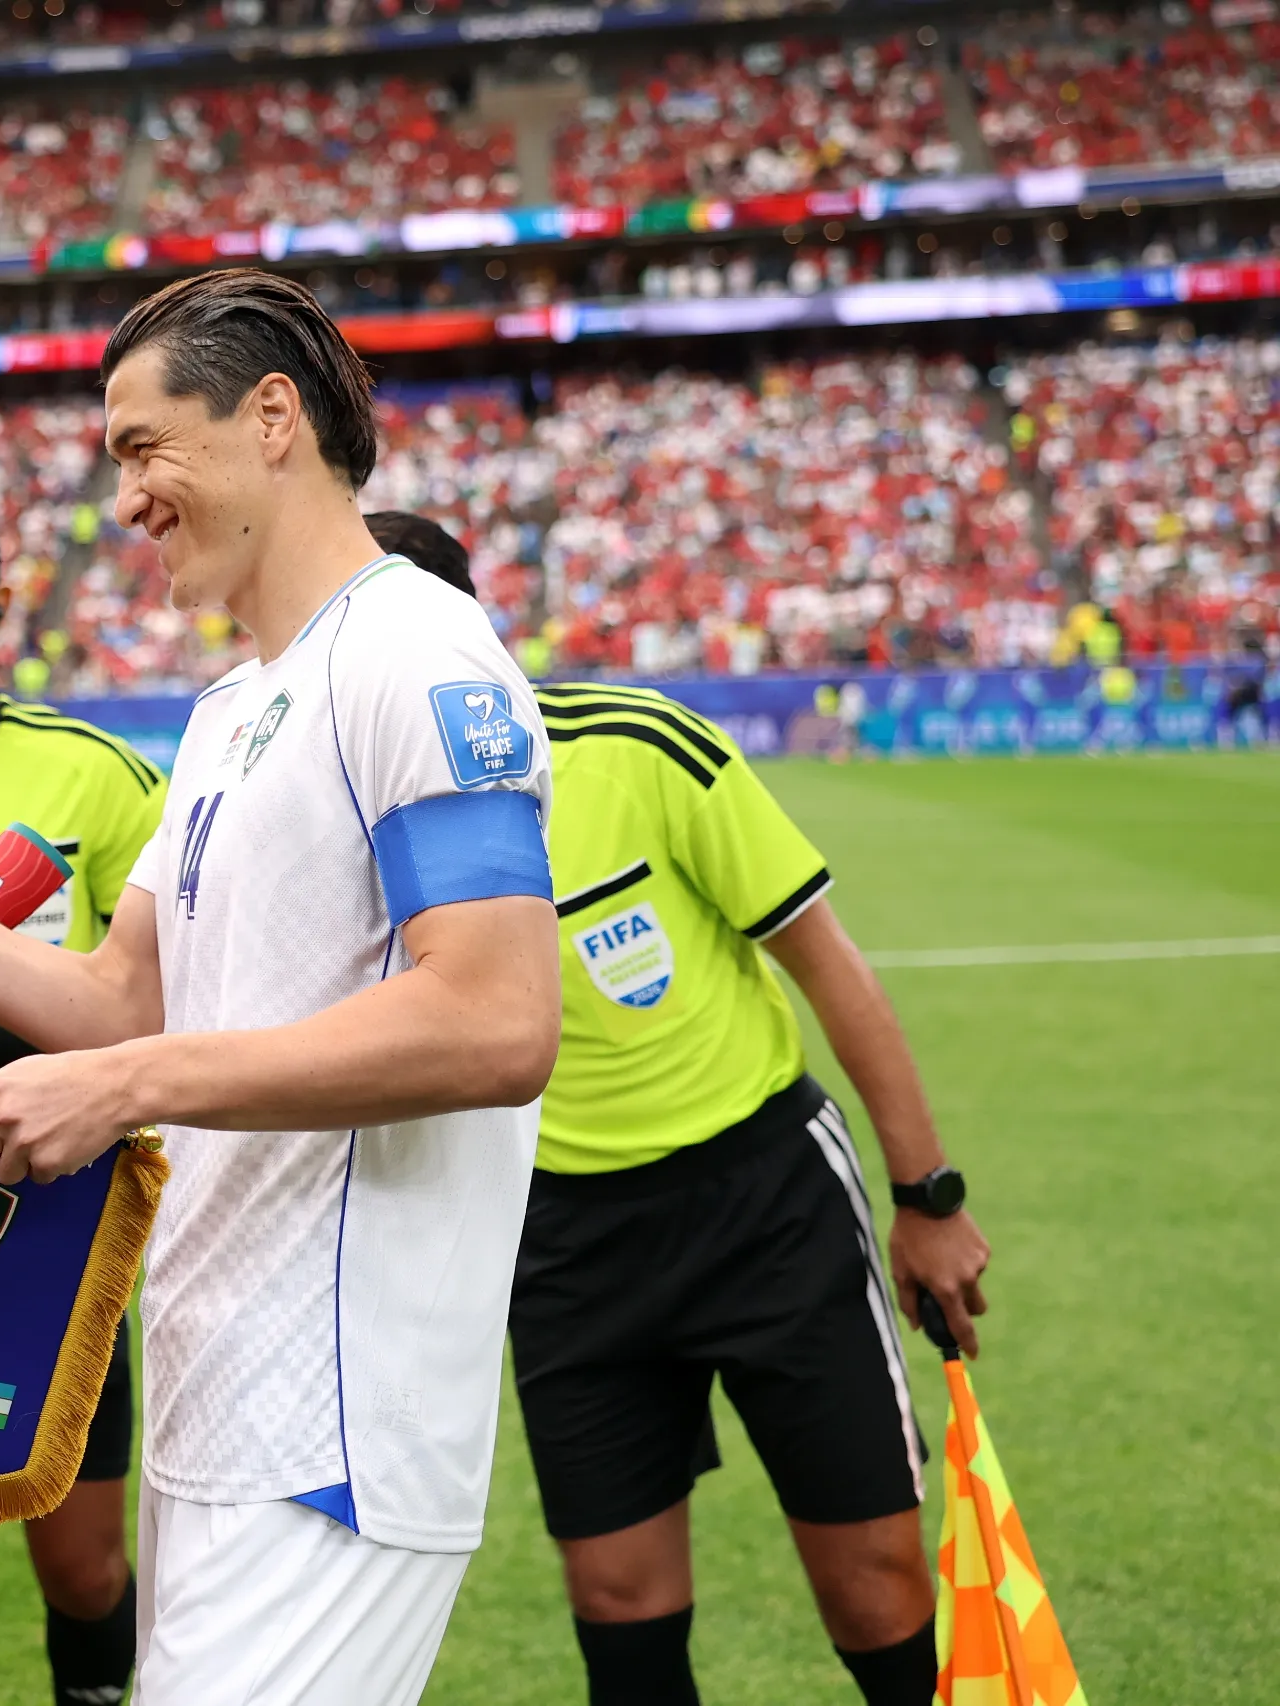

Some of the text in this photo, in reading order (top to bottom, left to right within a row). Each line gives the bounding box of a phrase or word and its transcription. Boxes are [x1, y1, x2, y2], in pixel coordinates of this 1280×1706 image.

[465, 719, 511, 743] Unite For
[471, 737, 514, 760] PEACE
[484, 759, 505, 770] FIFA
[583, 914, 652, 958] FIFA
